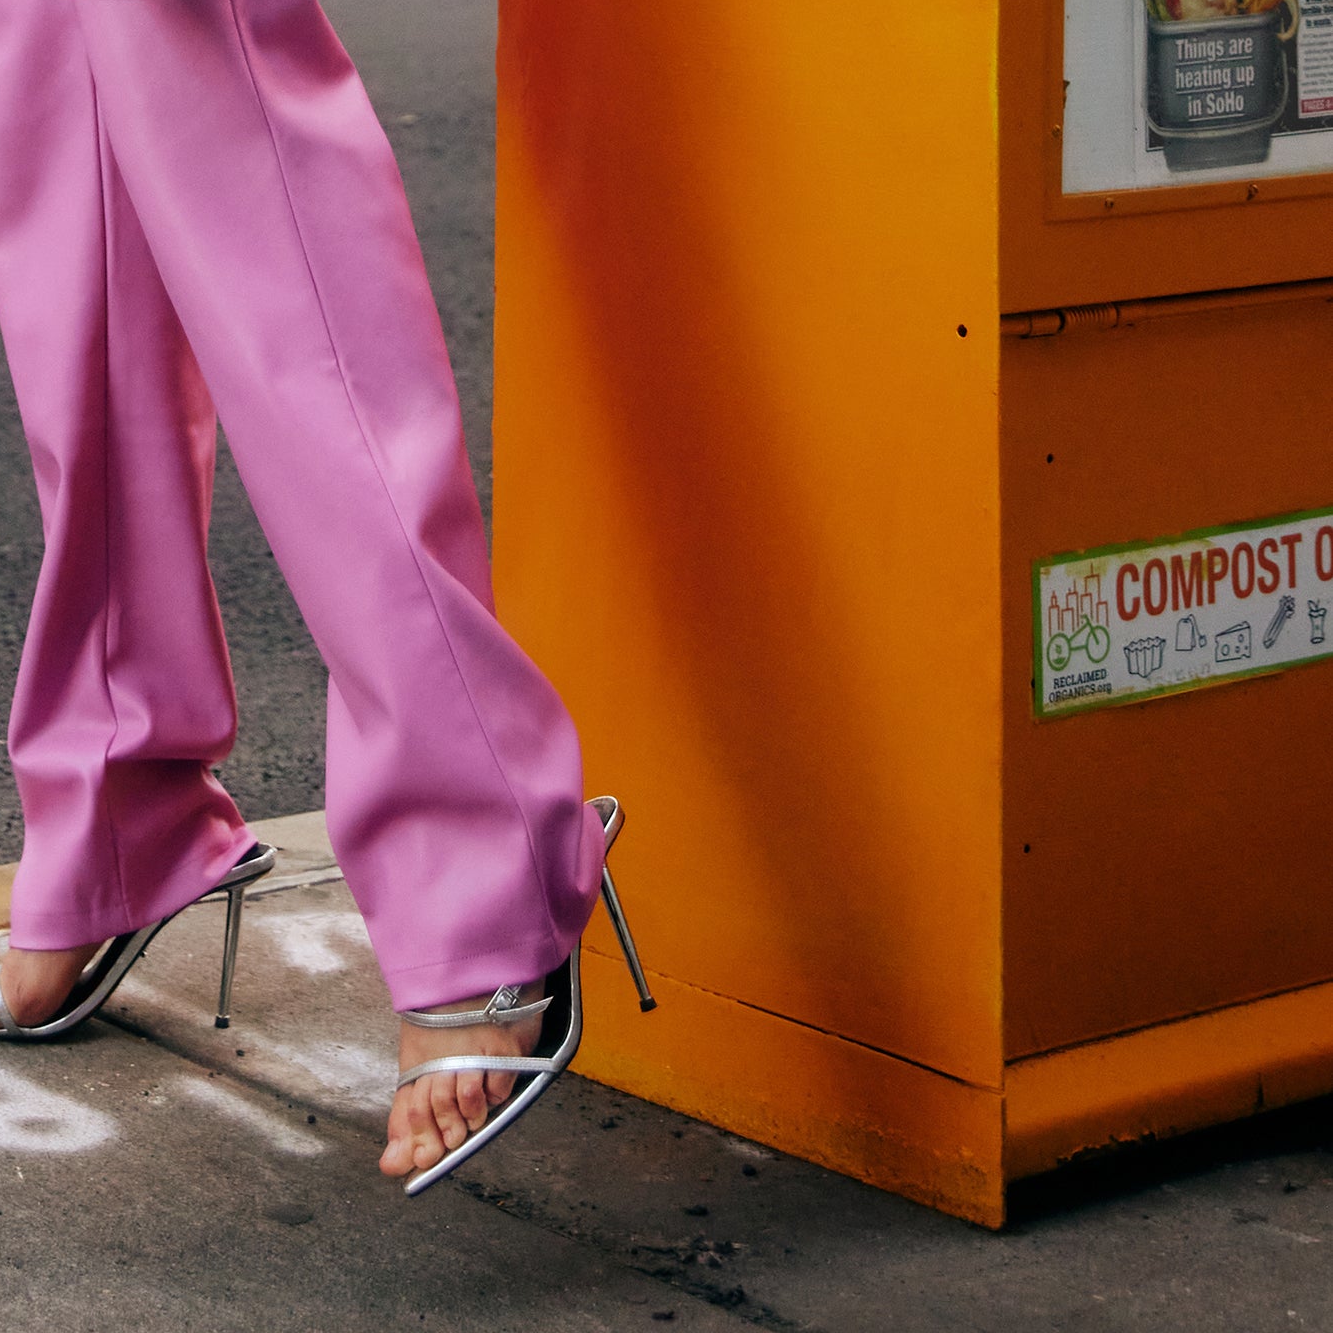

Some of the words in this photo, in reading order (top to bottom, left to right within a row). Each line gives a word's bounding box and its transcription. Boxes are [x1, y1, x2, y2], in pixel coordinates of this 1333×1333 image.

[1175, 37, 1225, 62] Things
[1228, 37, 1253, 55] are
[1175, 65, 1232, 89] heating
[1235, 65, 1255, 86] up
[1188, 96, 1202, 117] in
[1206, 91, 1245, 114] SoHo
[1116, 533, 1302, 621] COMPOST
[1053, 668, 1108, 690] RECLAIMED
[1048, 683, 1113, 703] ORGANICS.org
